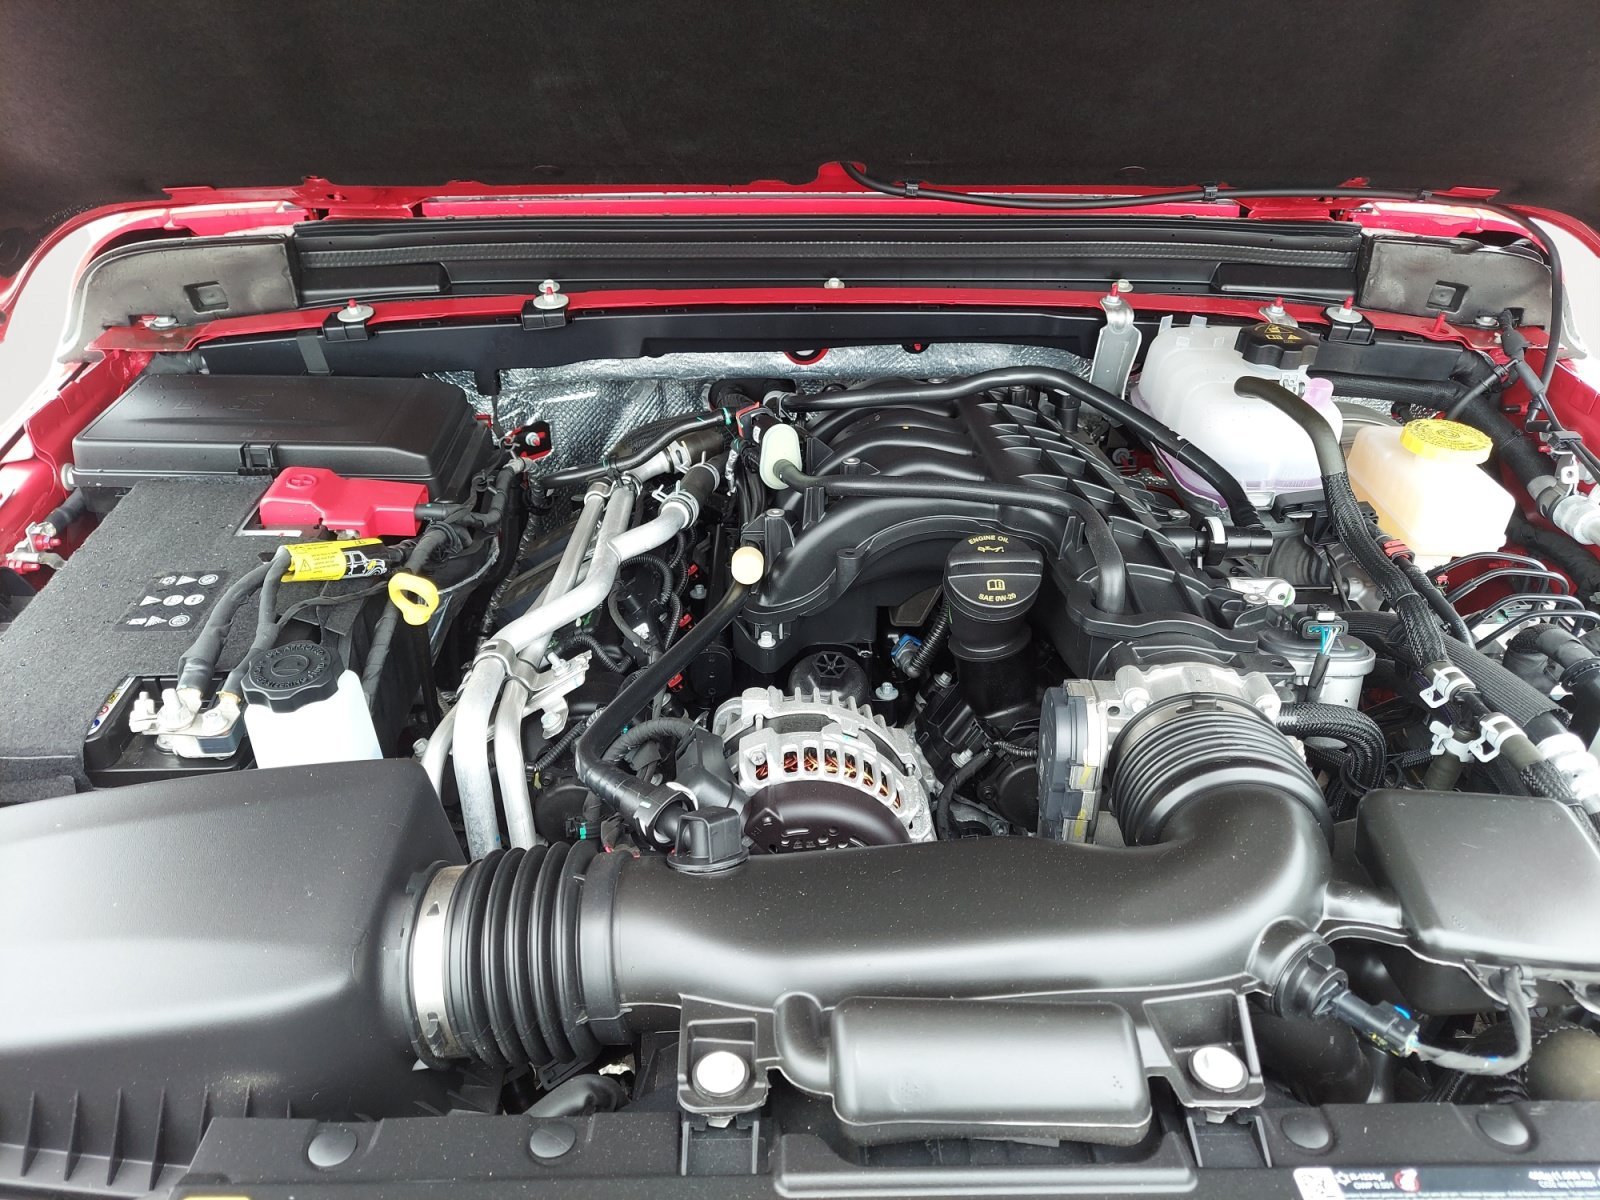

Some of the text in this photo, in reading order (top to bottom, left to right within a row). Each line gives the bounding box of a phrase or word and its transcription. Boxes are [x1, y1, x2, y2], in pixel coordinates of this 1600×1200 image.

[968, 535, 1010, 545] ENGINE OIL
[978, 593, 994, 602] SAE
